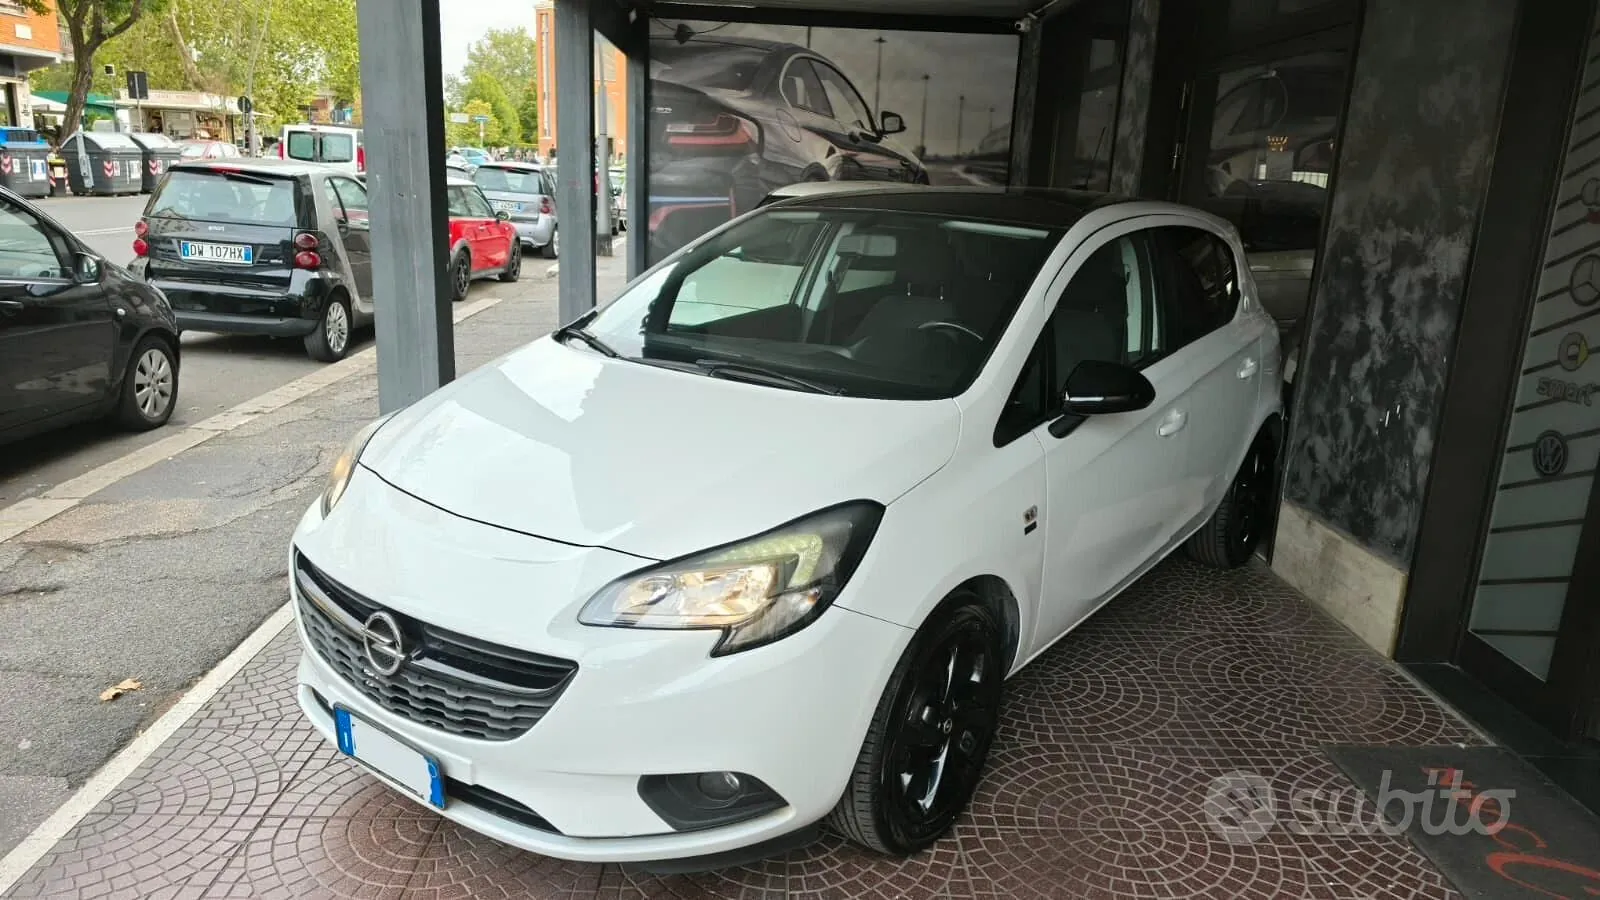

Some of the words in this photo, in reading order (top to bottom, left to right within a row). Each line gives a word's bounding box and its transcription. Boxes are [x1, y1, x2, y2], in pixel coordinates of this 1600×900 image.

[190, 244, 204, 257] DW
[209, 245, 243, 260] 107HX
[1536, 377, 1593, 407] smart
